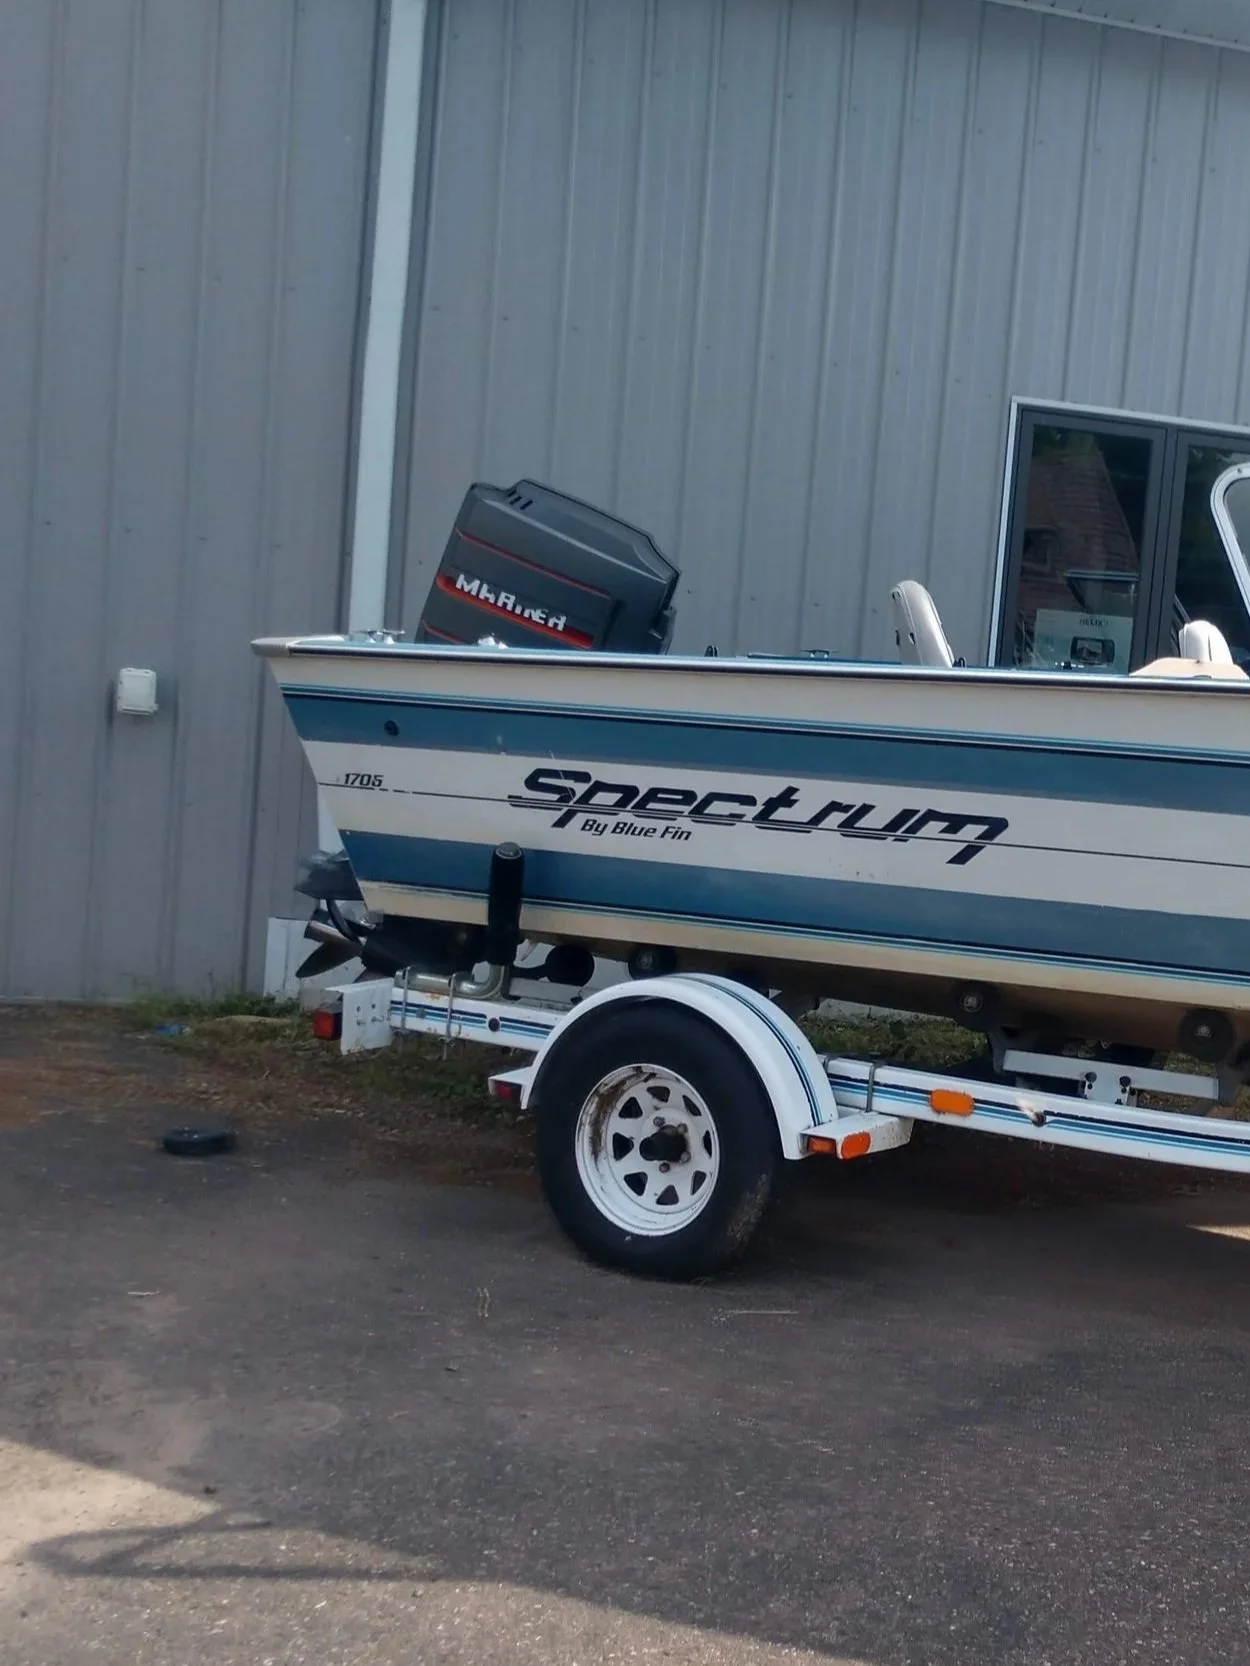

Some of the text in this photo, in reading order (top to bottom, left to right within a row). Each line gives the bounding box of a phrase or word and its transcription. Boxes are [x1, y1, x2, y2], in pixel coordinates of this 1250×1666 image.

[344, 772, 385, 788] 1705
[507, 767, 1009, 866] Spectrum
[580, 818, 692, 841] By Blue Fin
